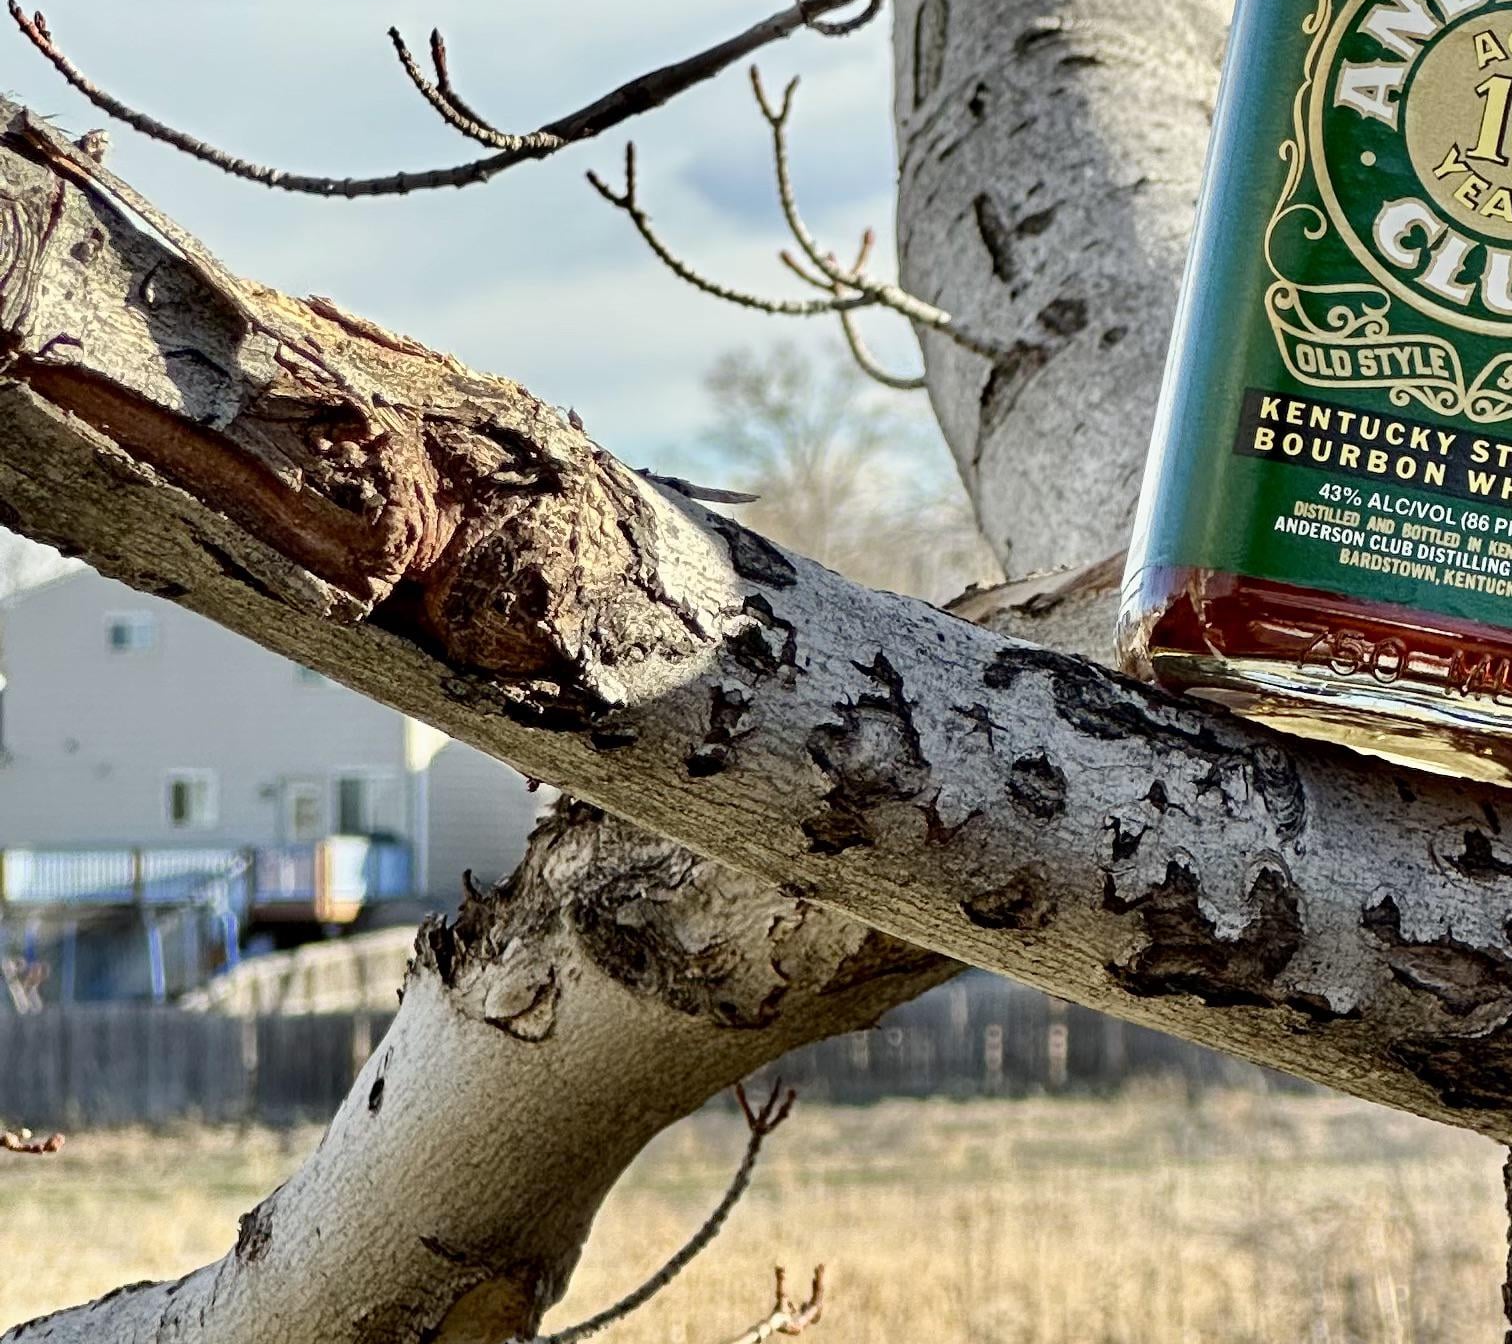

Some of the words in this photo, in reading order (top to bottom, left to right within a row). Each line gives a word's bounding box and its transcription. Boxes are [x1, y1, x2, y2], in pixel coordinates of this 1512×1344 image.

[1296, 343, 1353, 377] OLD
[1358, 345, 1450, 379] STYLE
[1259, 396, 1457, 456] KENTUCKY
[1254, 427, 1447, 487] BOURBON
[1294, 500, 1361, 527] DISTILLED
[1367, 516, 1395, 534] AND
[1401, 522, 1461, 547] BOTTLED
[1467, 536, 1481, 553] IN
[1318, 483, 1362, 506] 43%
[1367, 492, 1457, 526] ALC/VOL
[1460, 511, 1490, 532] (86
[1274, 516, 1364, 548] ANDERSON
[1369, 534, 1414, 557] CLUB
[1417, 542, 1511, 577] DISTILLING
[1339, 548, 1440, 586] BARDSTOWN,
